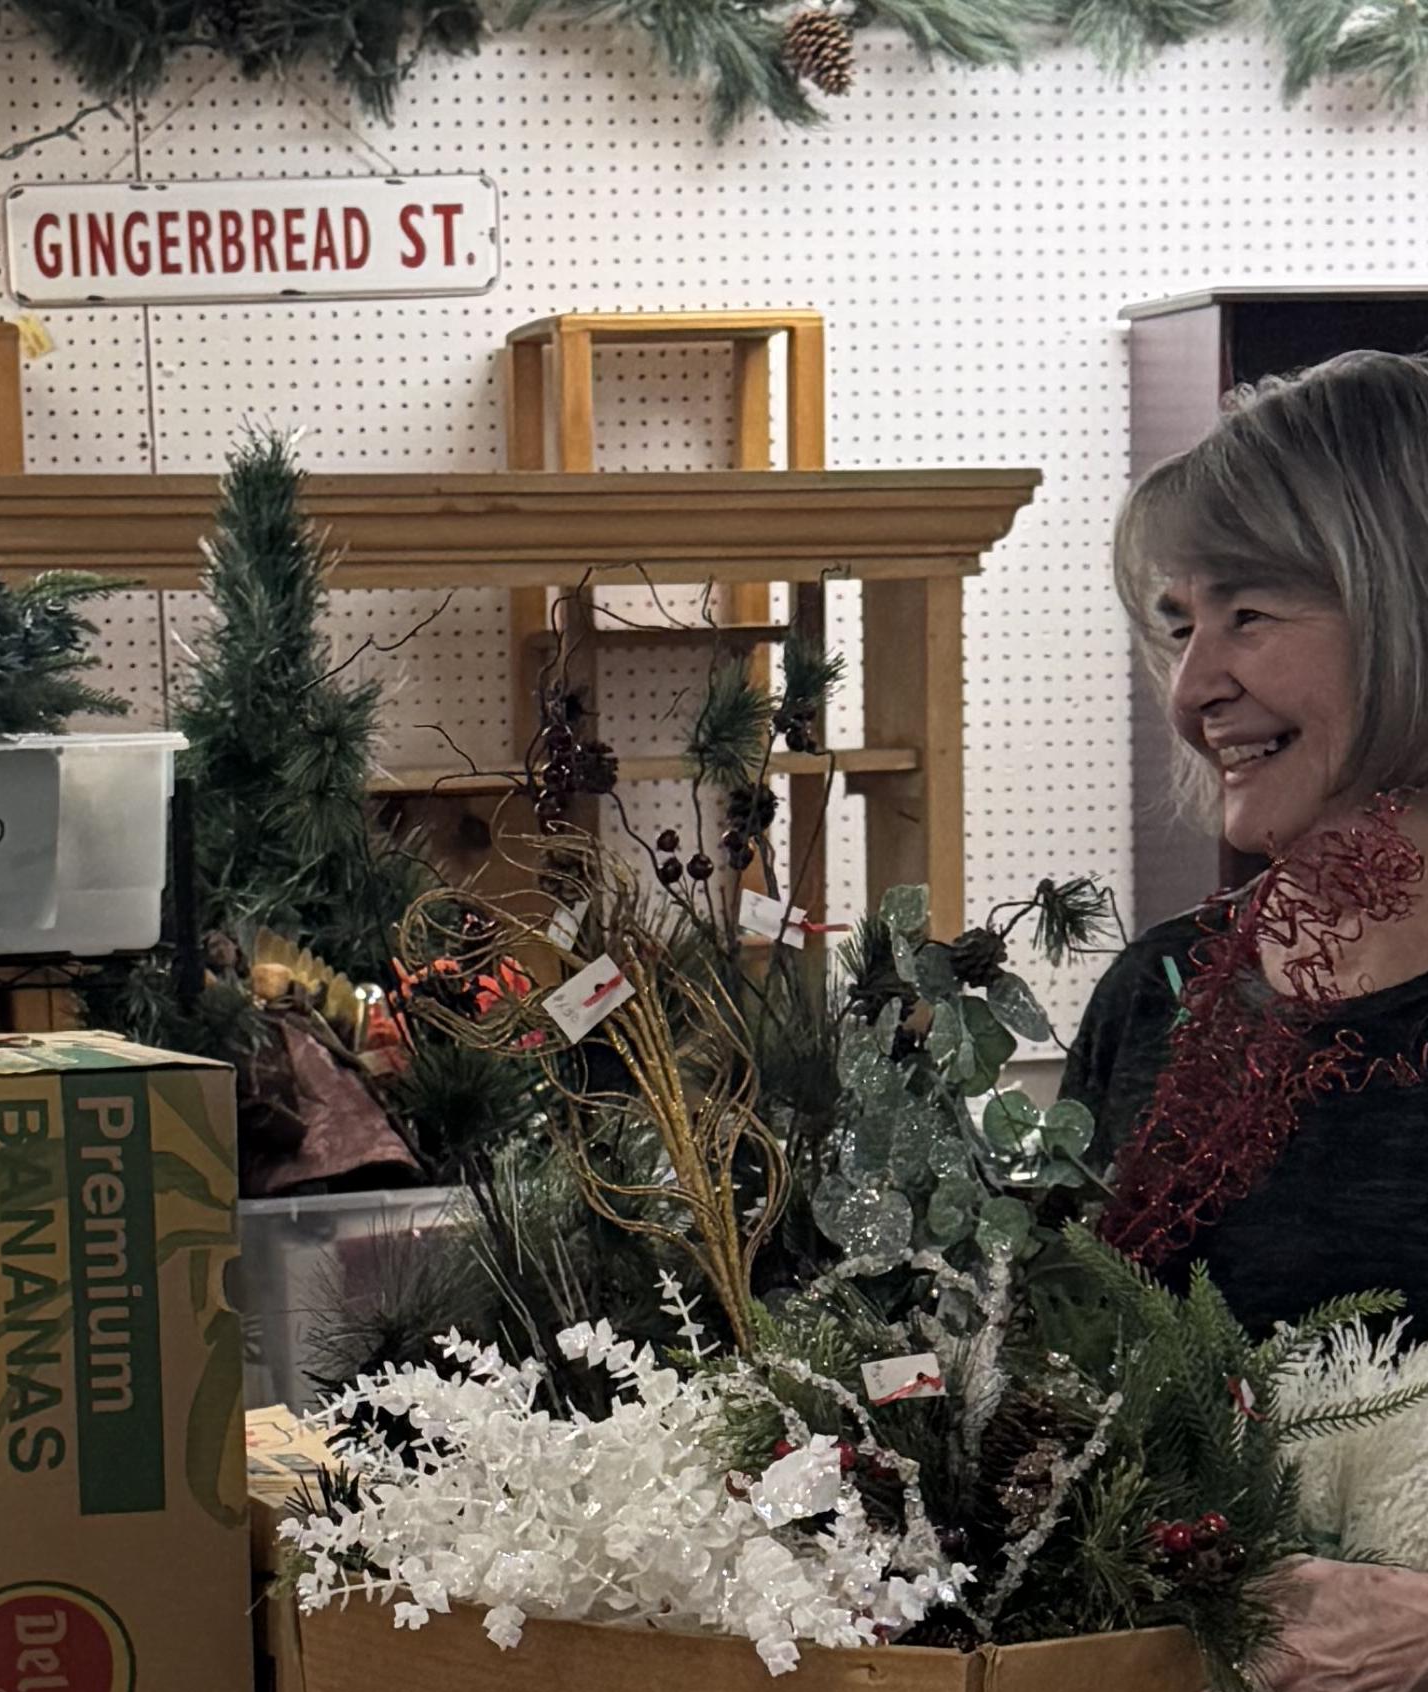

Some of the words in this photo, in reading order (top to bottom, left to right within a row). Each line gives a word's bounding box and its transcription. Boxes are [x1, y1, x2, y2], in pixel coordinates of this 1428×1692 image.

[33, 206, 372, 280] GINGERBREAD
[398, 202, 477, 270] ST.
[76, 1095, 144, 1415] Premium
